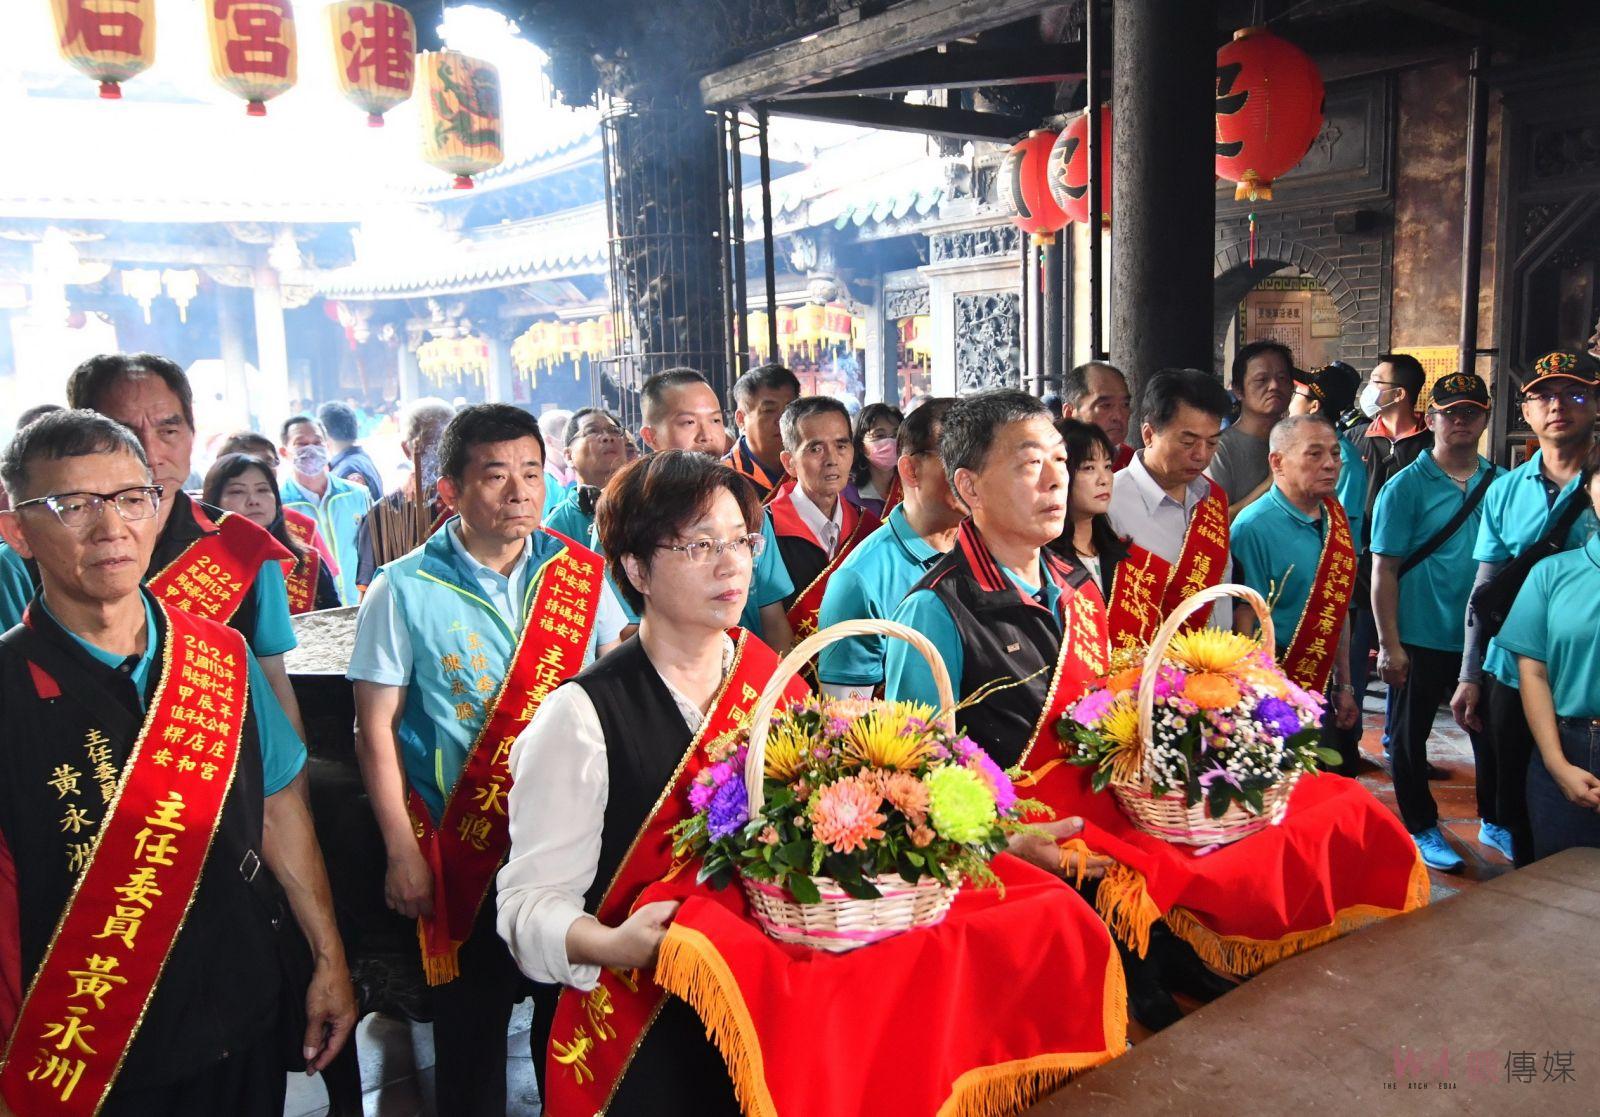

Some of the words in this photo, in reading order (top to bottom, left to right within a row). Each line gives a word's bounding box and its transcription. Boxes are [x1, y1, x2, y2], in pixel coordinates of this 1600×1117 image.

[214, 0, 292, 78] 宮
[341, 2, 413, 91] 港
[197, 555, 243, 592] 2024
[549, 583, 588, 611] 十二庄
[539, 614, 583, 644] 福安宮
[183, 634, 236, 667] 2024
[185, 649, 236, 682] 民國113年
[178, 685, 233, 719] 甲辰年
[171, 705, 231, 736] 值年大公館
[162, 724, 227, 758] 粿店庄
[83, 728, 118, 804] 主任委員
[152, 748, 219, 780] 安和宮
[47, 763, 97, 872] 黃永洲
[92, 791, 186, 950] 主任委員
[27, 953, 128, 1102] 黃永洲
